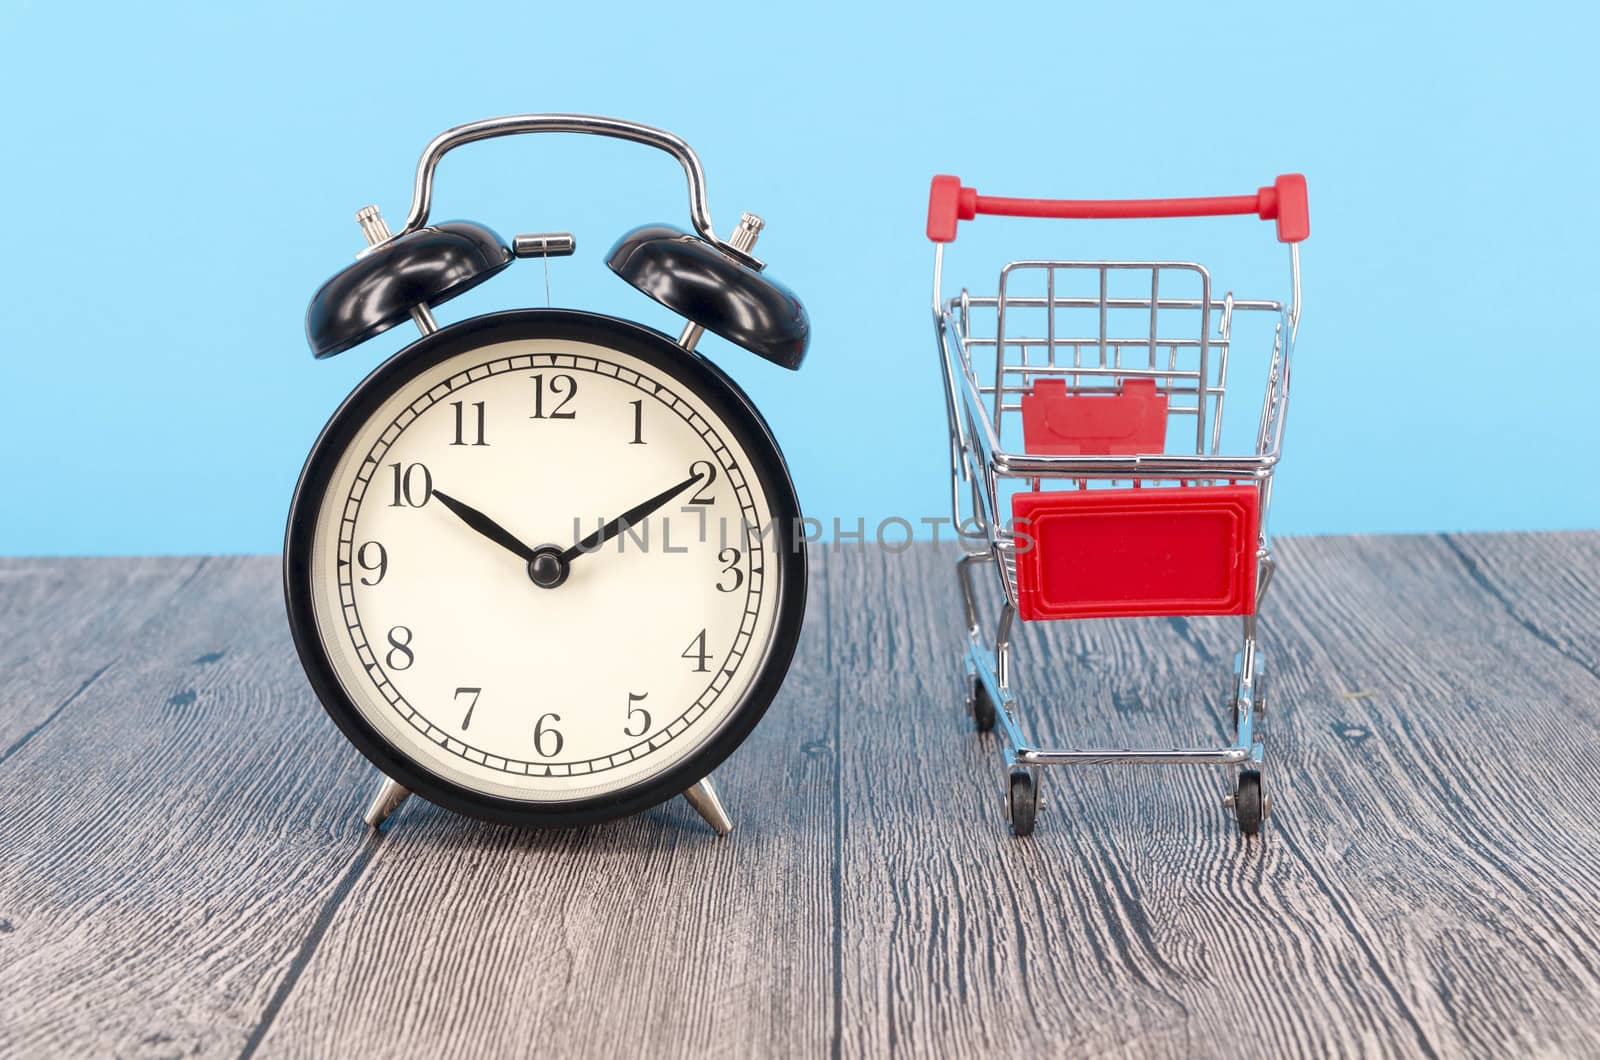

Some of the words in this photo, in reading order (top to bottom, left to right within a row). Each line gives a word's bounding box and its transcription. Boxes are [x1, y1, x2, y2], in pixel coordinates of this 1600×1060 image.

[529, 374, 578, 420] 12
[448, 401, 491, 446] 11
[628, 399, 648, 445] 1
[387, 462, 433, 508] 10
[688, 460, 717, 505] 2
[357, 541, 388, 586] 9
[716, 547, 744, 592] 3
[386, 625, 415, 671] 8
[681, 628, 714, 673] 4
[454, 686, 482, 731] 7
[624, 692, 652, 737] 5
[533, 713, 564, 758] 6
